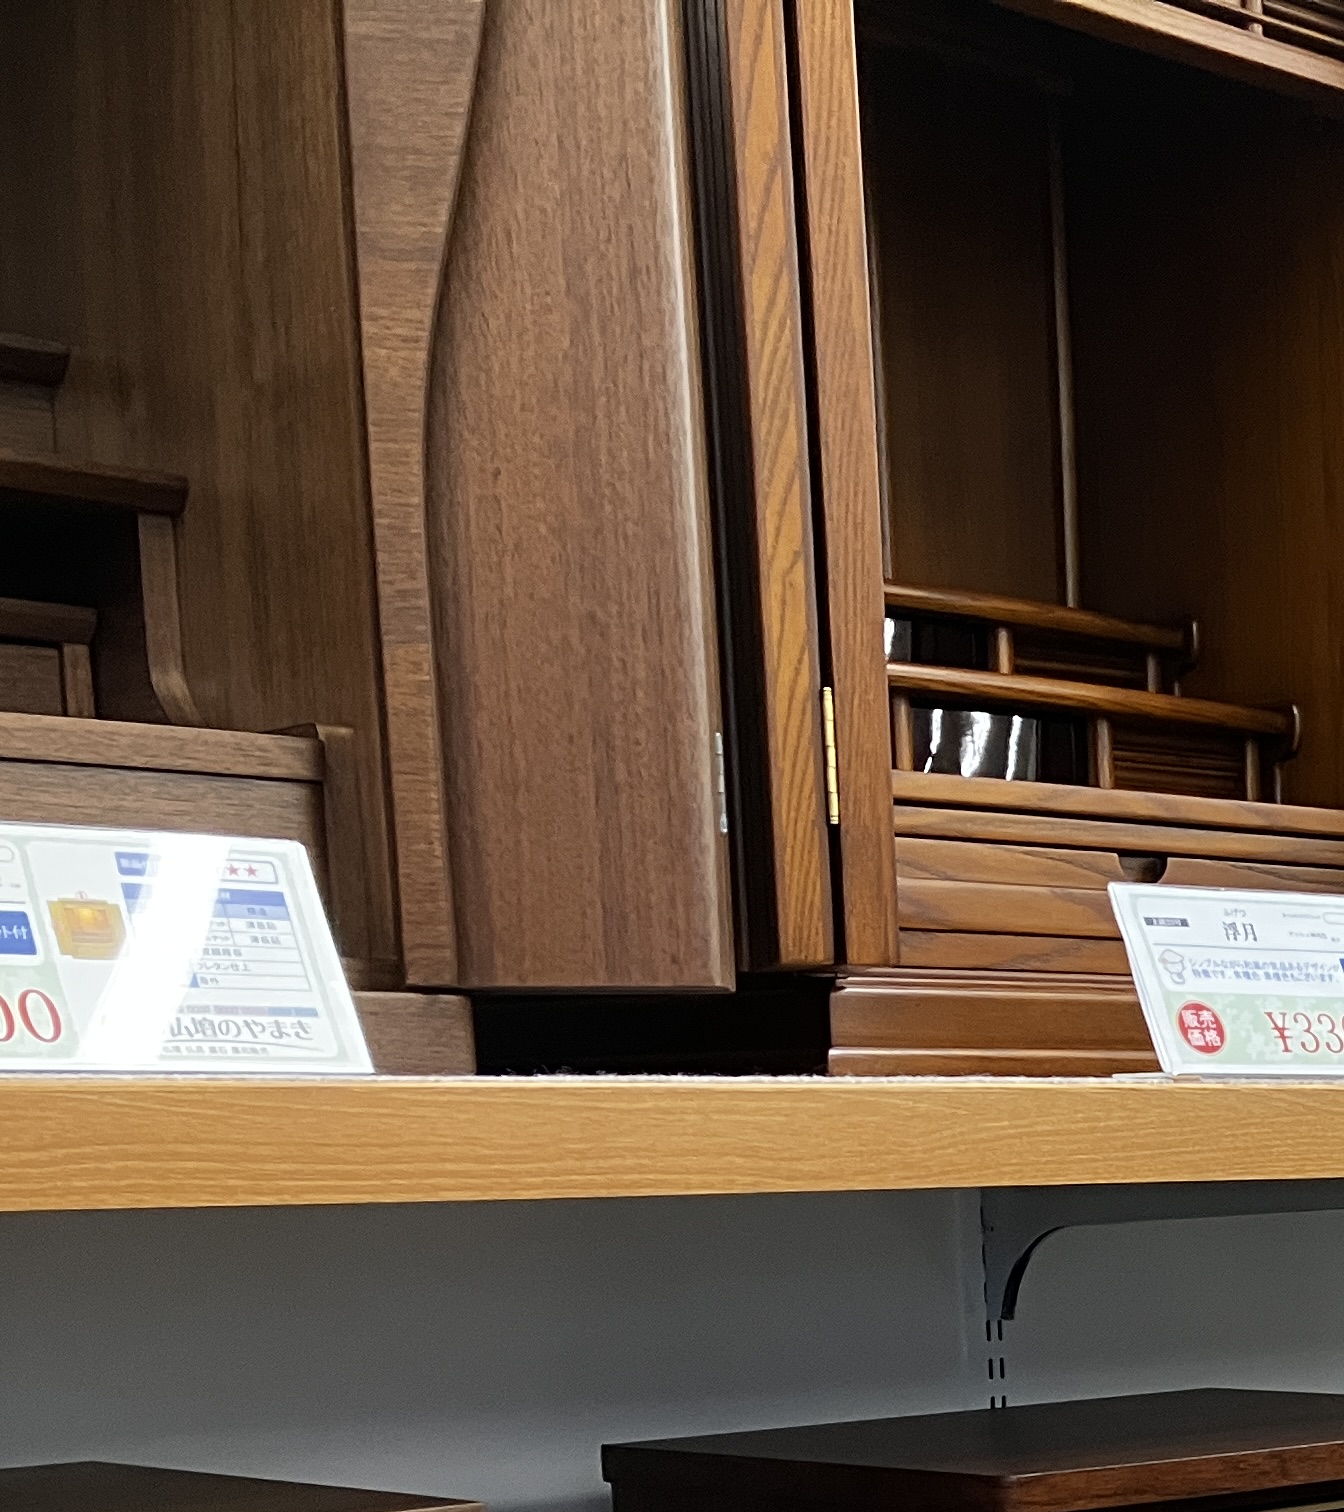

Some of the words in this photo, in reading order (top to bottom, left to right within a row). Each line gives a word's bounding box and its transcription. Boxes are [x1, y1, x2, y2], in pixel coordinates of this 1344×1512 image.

[1222, 920, 1258, 942] 浮月
[1181, 1009, 1217, 1029] 販売
[1187, 1028, 1222, 1048] 価格
